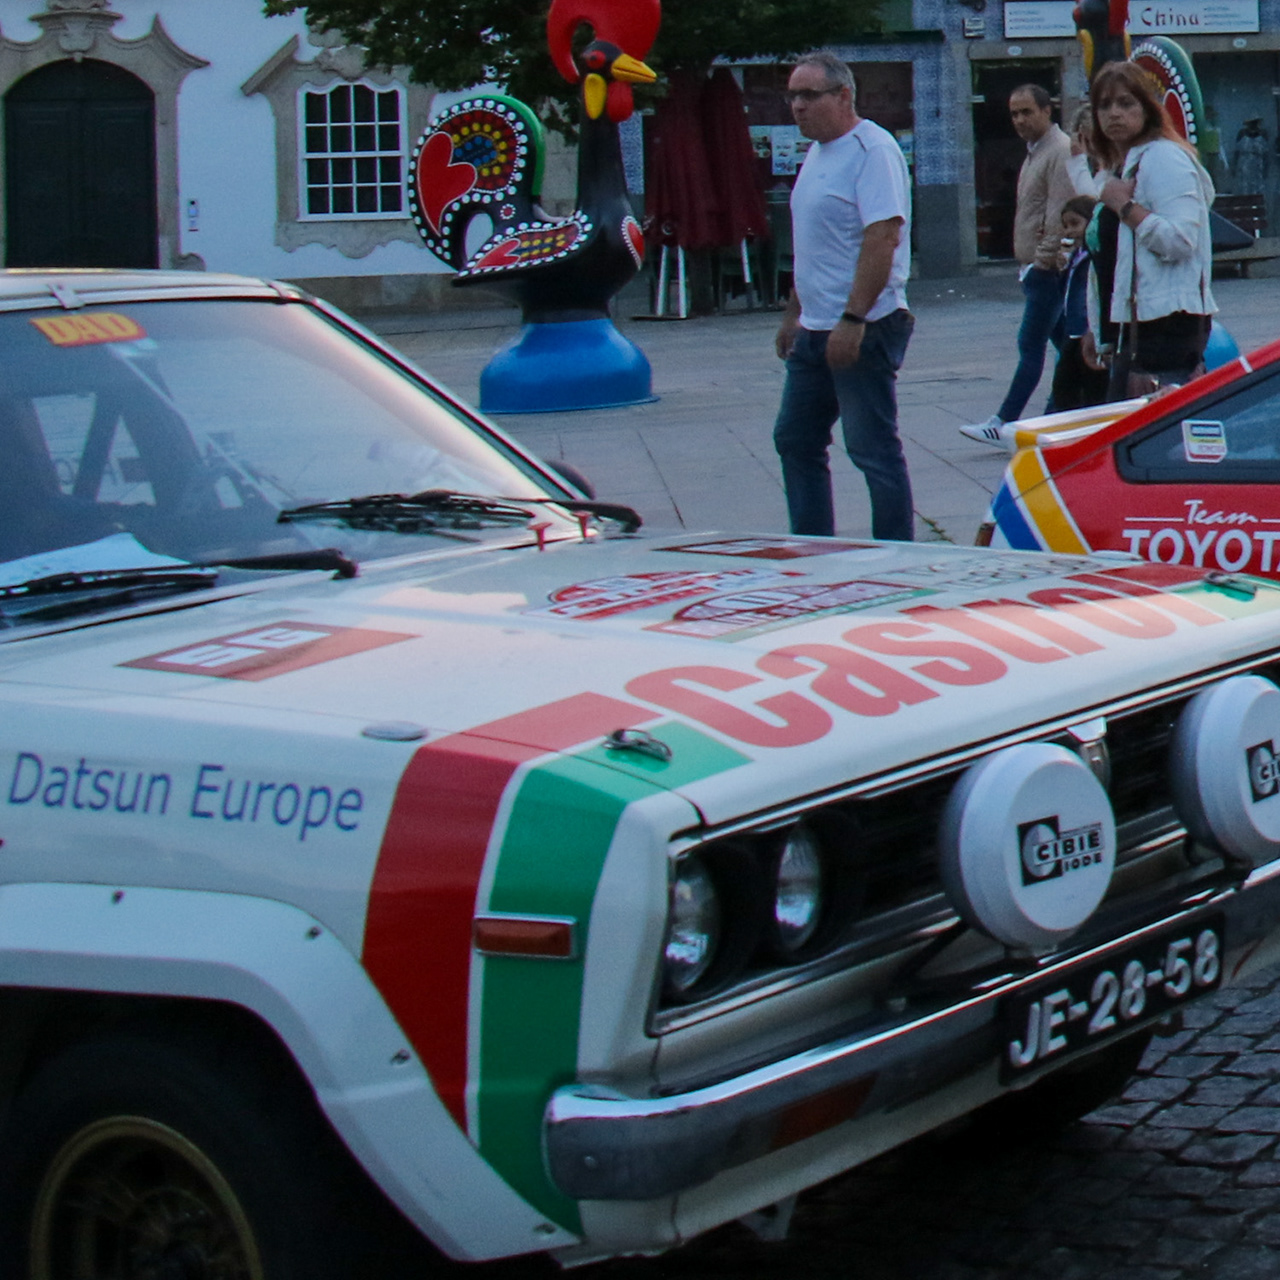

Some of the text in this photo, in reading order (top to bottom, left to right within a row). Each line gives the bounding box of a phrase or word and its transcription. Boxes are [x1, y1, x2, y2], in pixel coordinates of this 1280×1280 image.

[1141, 7, 1200, 26] China
[1184, 499, 1259, 525] Team
[626, 572, 1226, 748] Castrol
[7, 752, 364, 842] Datsun Europe
[1009, 929, 1220, 1067] JE-28-58
